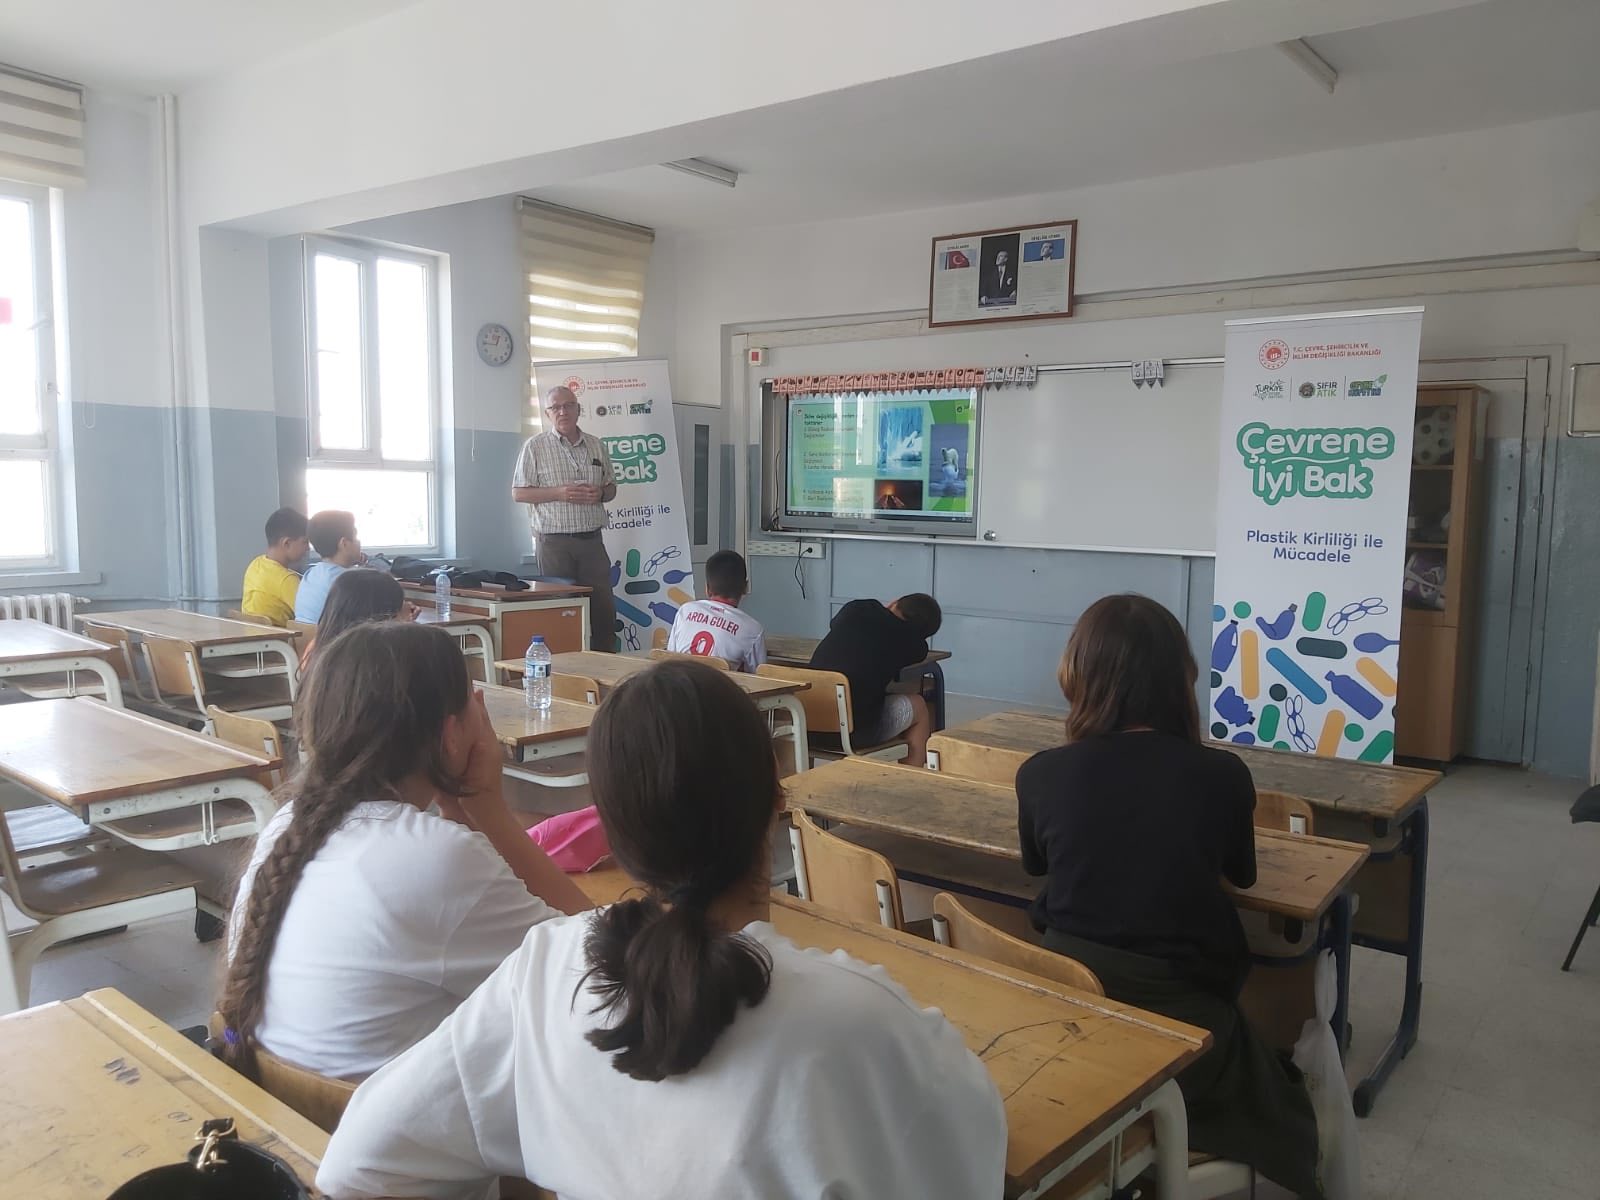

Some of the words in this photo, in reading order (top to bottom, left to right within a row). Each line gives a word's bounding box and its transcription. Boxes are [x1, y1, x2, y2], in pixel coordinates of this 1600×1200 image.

[1316, 389, 1337, 398] ATIK
[1317, 381, 1338, 389] SIFIR
[603, 437, 662, 455] rene
[1241, 427, 1389, 464] Çevrene
[1258, 458, 1294, 500] İyi
[1303, 463, 1367, 494] Bak
[617, 504, 654, 518] Kirliliği
[658, 504, 671, 515] ile
[1247, 529, 1298, 545] Plastik
[1303, 532, 1358, 550] Kirliliği
[1363, 534, 1384, 548] ile
[1273, 546, 1351, 563] Mücadele
[686, 611, 710, 625] ARDA
